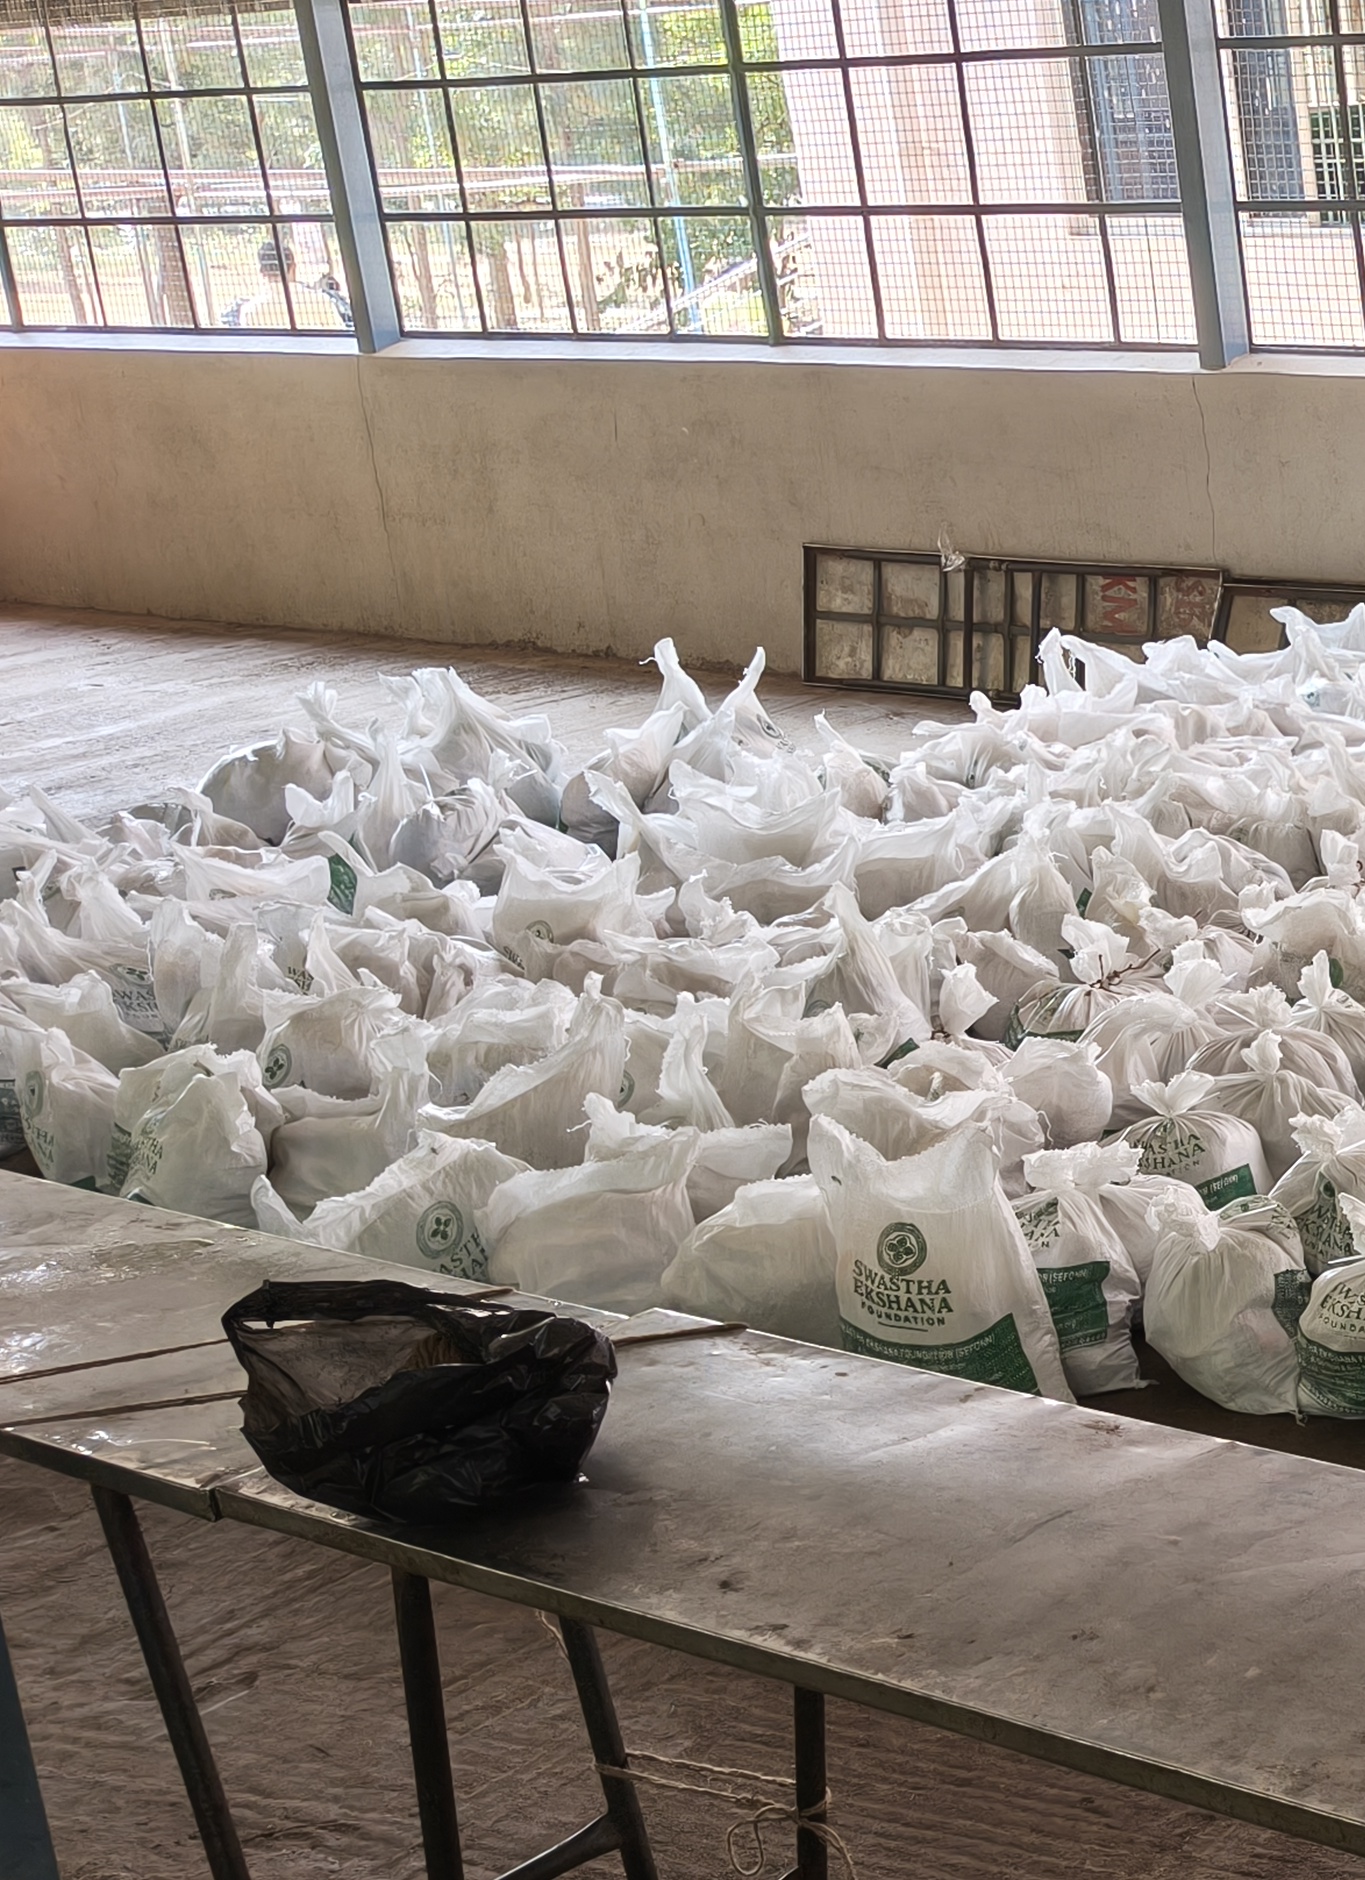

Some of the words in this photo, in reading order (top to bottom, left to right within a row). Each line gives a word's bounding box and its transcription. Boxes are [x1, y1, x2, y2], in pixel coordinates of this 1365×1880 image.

[852, 1259, 952, 1296] SWASTHA
[852, 1275, 954, 1315] EKSHANA
[861, 1301, 946, 1326] FOUNDATION
